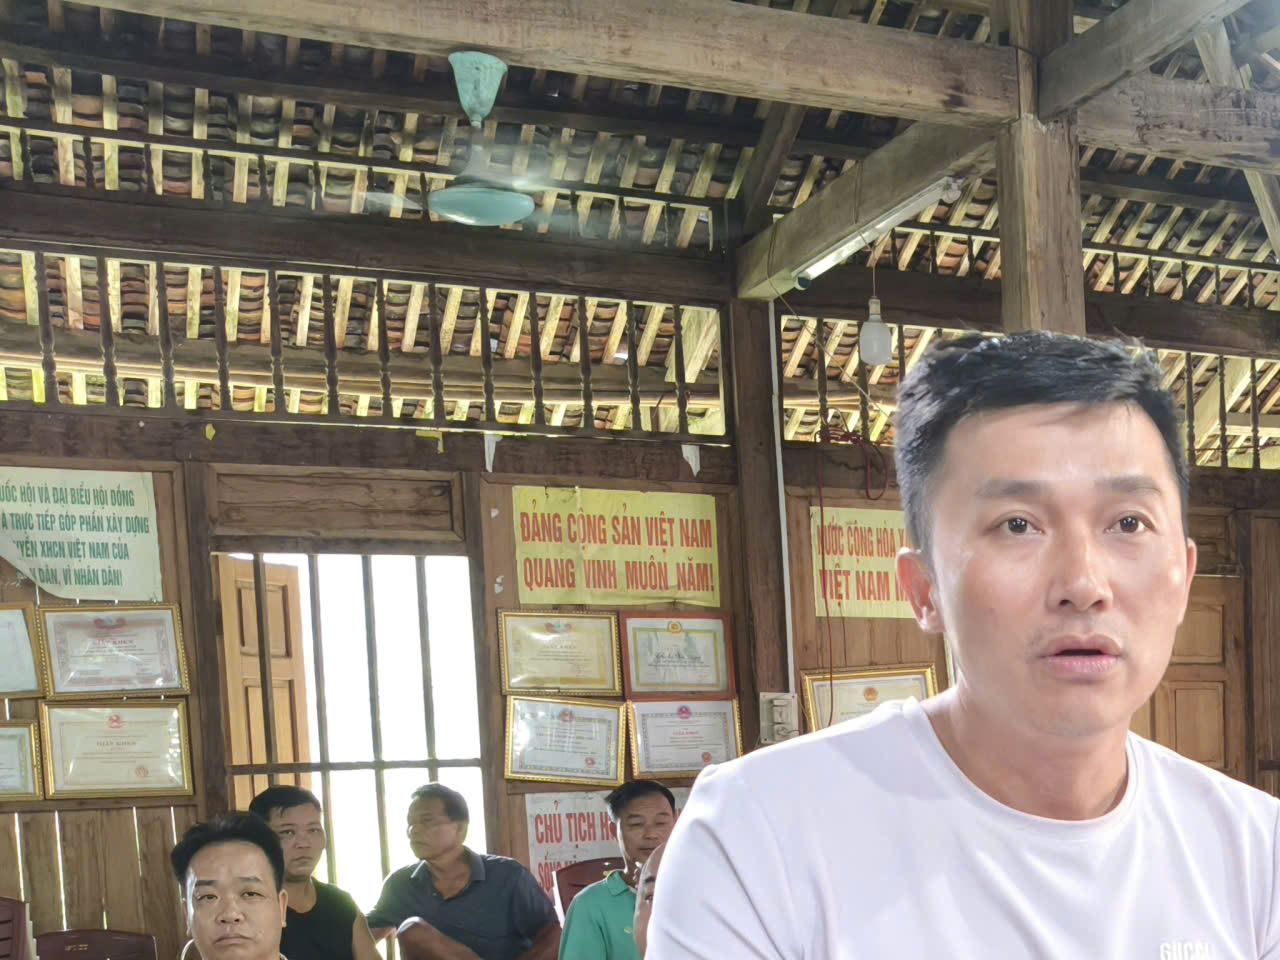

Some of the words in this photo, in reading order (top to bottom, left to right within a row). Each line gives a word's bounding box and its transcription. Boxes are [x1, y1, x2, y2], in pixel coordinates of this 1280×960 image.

[20, 482, 36, 507] HỘI
[52, 486, 69, 507] ĐẠI
[70, 481, 91, 505] BIỂU
[92, 485, 109, 509] HỘI
[9, 511, 34, 534] TRỰC
[36, 508, 56, 531] TIẾP
[58, 510, 77, 531] GÓP
[106, 512, 123, 533] XÂY
[125, 515, 150, 537] DỰNG
[520, 499, 562, 543] ĐẢNG
[567, 507, 607, 550] CỘNG
[612, 503, 641, 546] SẢN
[645, 511, 675, 553] VIỆT
[679, 518, 713, 548] NAM
[16, 536, 38, 558] YỀN
[40, 541, 66, 559] XHCN
[67, 538, 86, 562] VIỆT
[89, 541, 110, 559] NAM
[112, 537, 130, 560] CỦA
[847, 520, 874, 564] CỘNG
[63, 565, 73, 585] VÌ
[74, 565, 99, 585] NHÂN
[101, 566, 123, 586] DÂN!
[523, 557, 576, 591] QUANG
[583, 559, 617, 589] VINH
[625, 555, 669, 590] MUÔN
[676, 556, 714, 592] NĂM!
[819, 563, 851, 607] VIỆT
[855, 570, 890, 601] NAM
[535, 800, 562, 844] CHỦ
[565, 812, 597, 848] TỊCH
